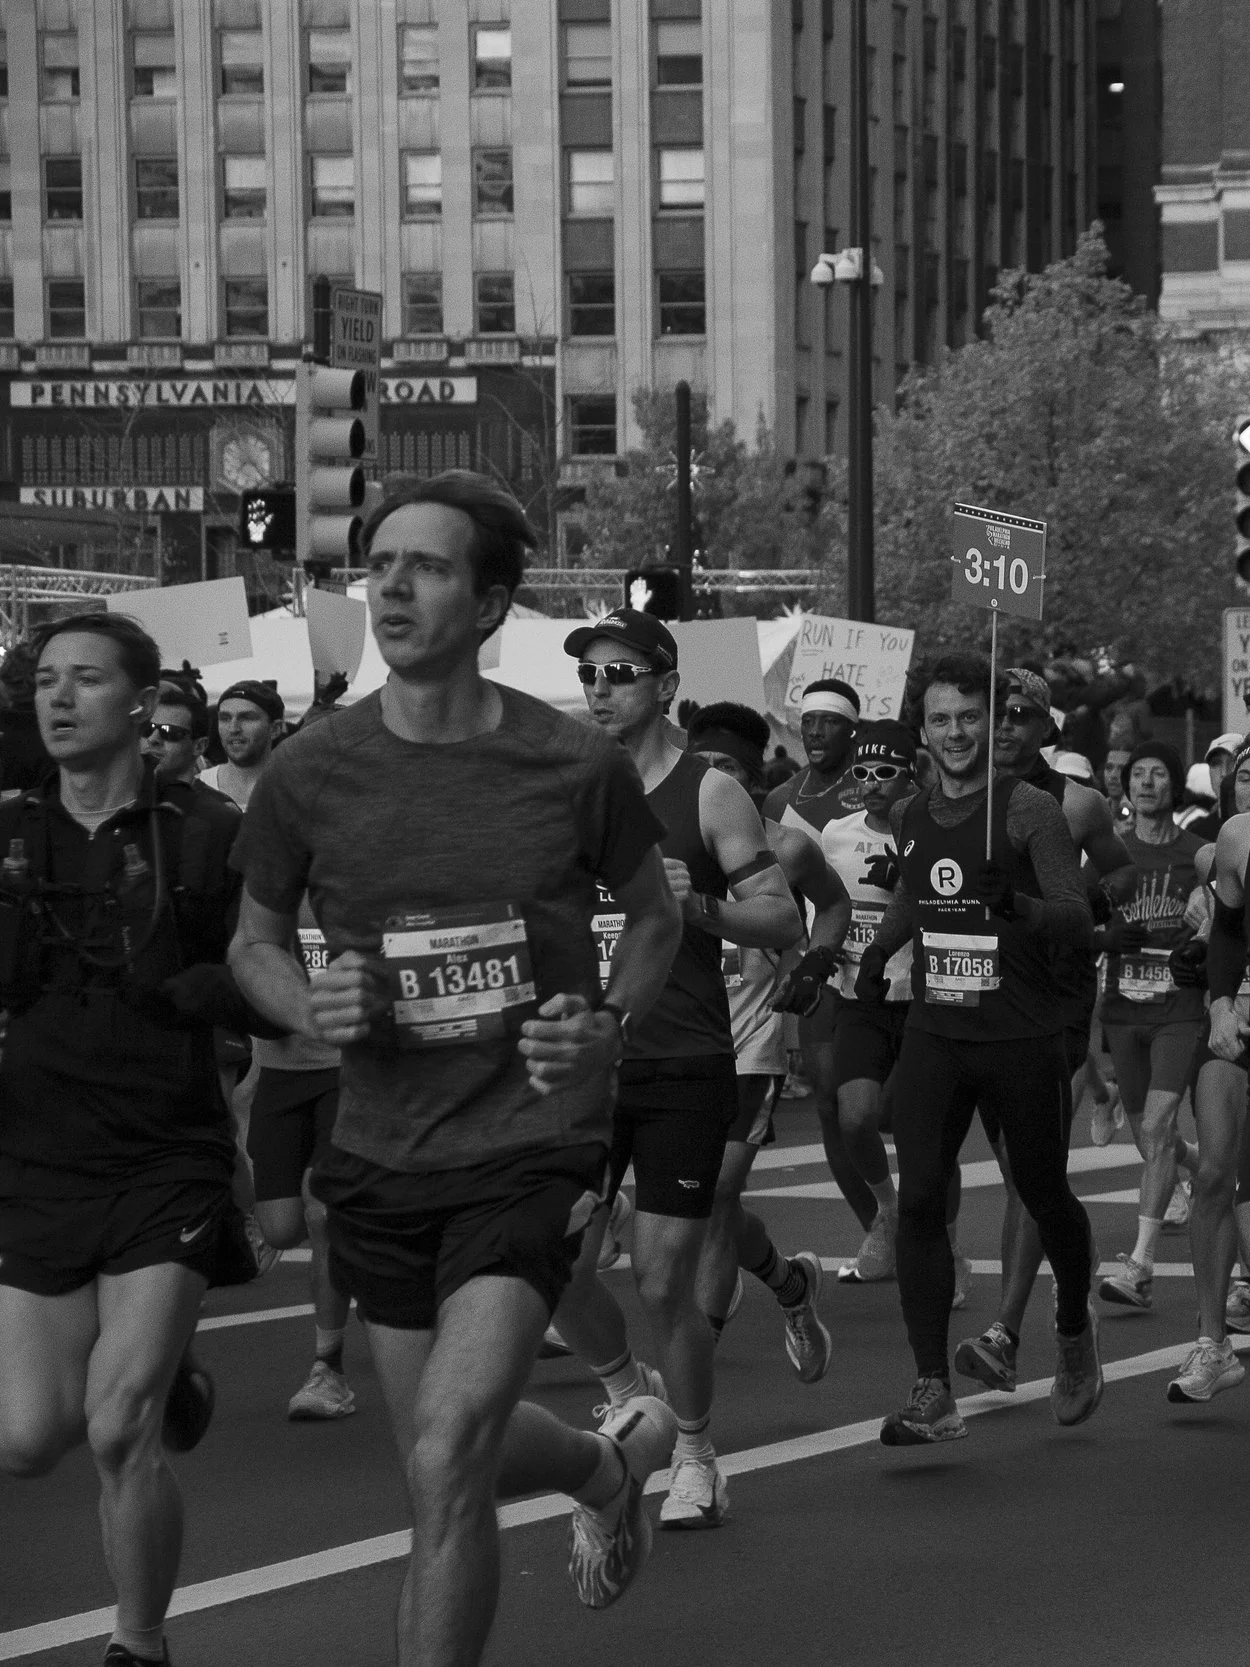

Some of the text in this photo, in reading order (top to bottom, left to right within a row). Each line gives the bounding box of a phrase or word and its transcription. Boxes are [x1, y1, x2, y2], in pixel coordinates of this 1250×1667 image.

[341, 316, 374, 343] YIELD
[31, 382, 265, 403] PENNSYLVANIA
[964, 547, 1029, 595] 3:10
[801, 620, 909, 651] RUN IF YOU
[822, 662, 868, 688] HATE
[858, 743, 886, 757] NIKE
[597, 920, 625, 929] MARATHO
[429, 934, 480, 949] MARATHON
[853, 927, 878, 944] 113
[446, 953, 469, 964] Alex
[948, 950, 970, 958] Lorenzo
[929, 955, 994, 977] B 17058
[1124, 964, 1133, 979] B
[399, 955, 520, 999] B 13481
